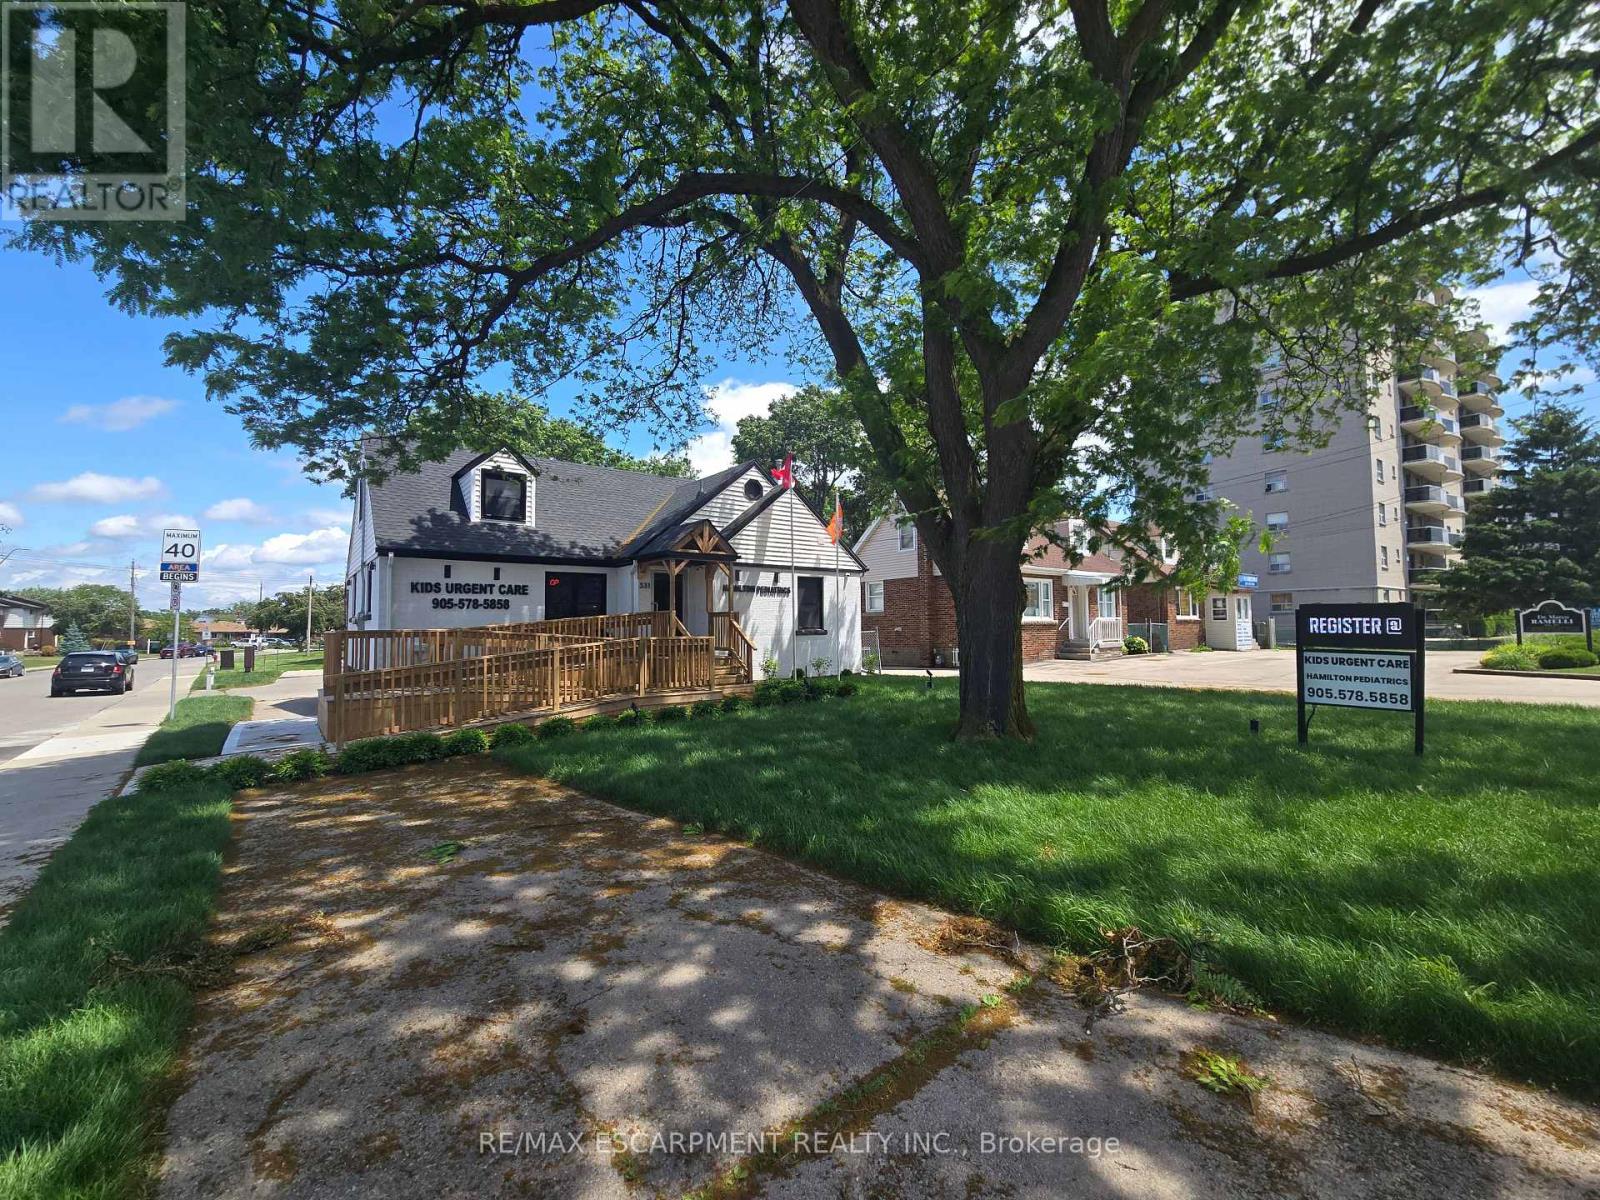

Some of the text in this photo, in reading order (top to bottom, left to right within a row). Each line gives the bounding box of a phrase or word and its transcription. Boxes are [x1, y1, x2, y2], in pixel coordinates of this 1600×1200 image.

[164, 543, 195, 558] 40
[162, 572, 195, 581] BEGINS
[410, 581, 529, 595] KIDS URGENT CARE
[431, 597, 510, 610] 905-578-5858
[1309, 617, 1382, 635] REGISTER
[1304, 656, 1410, 669] KIDS URGENT CARE
[1306, 672, 1409, 686] HAMILTON PEDIATRICS
[1306, 687, 1409, 706] 905.578.5858
